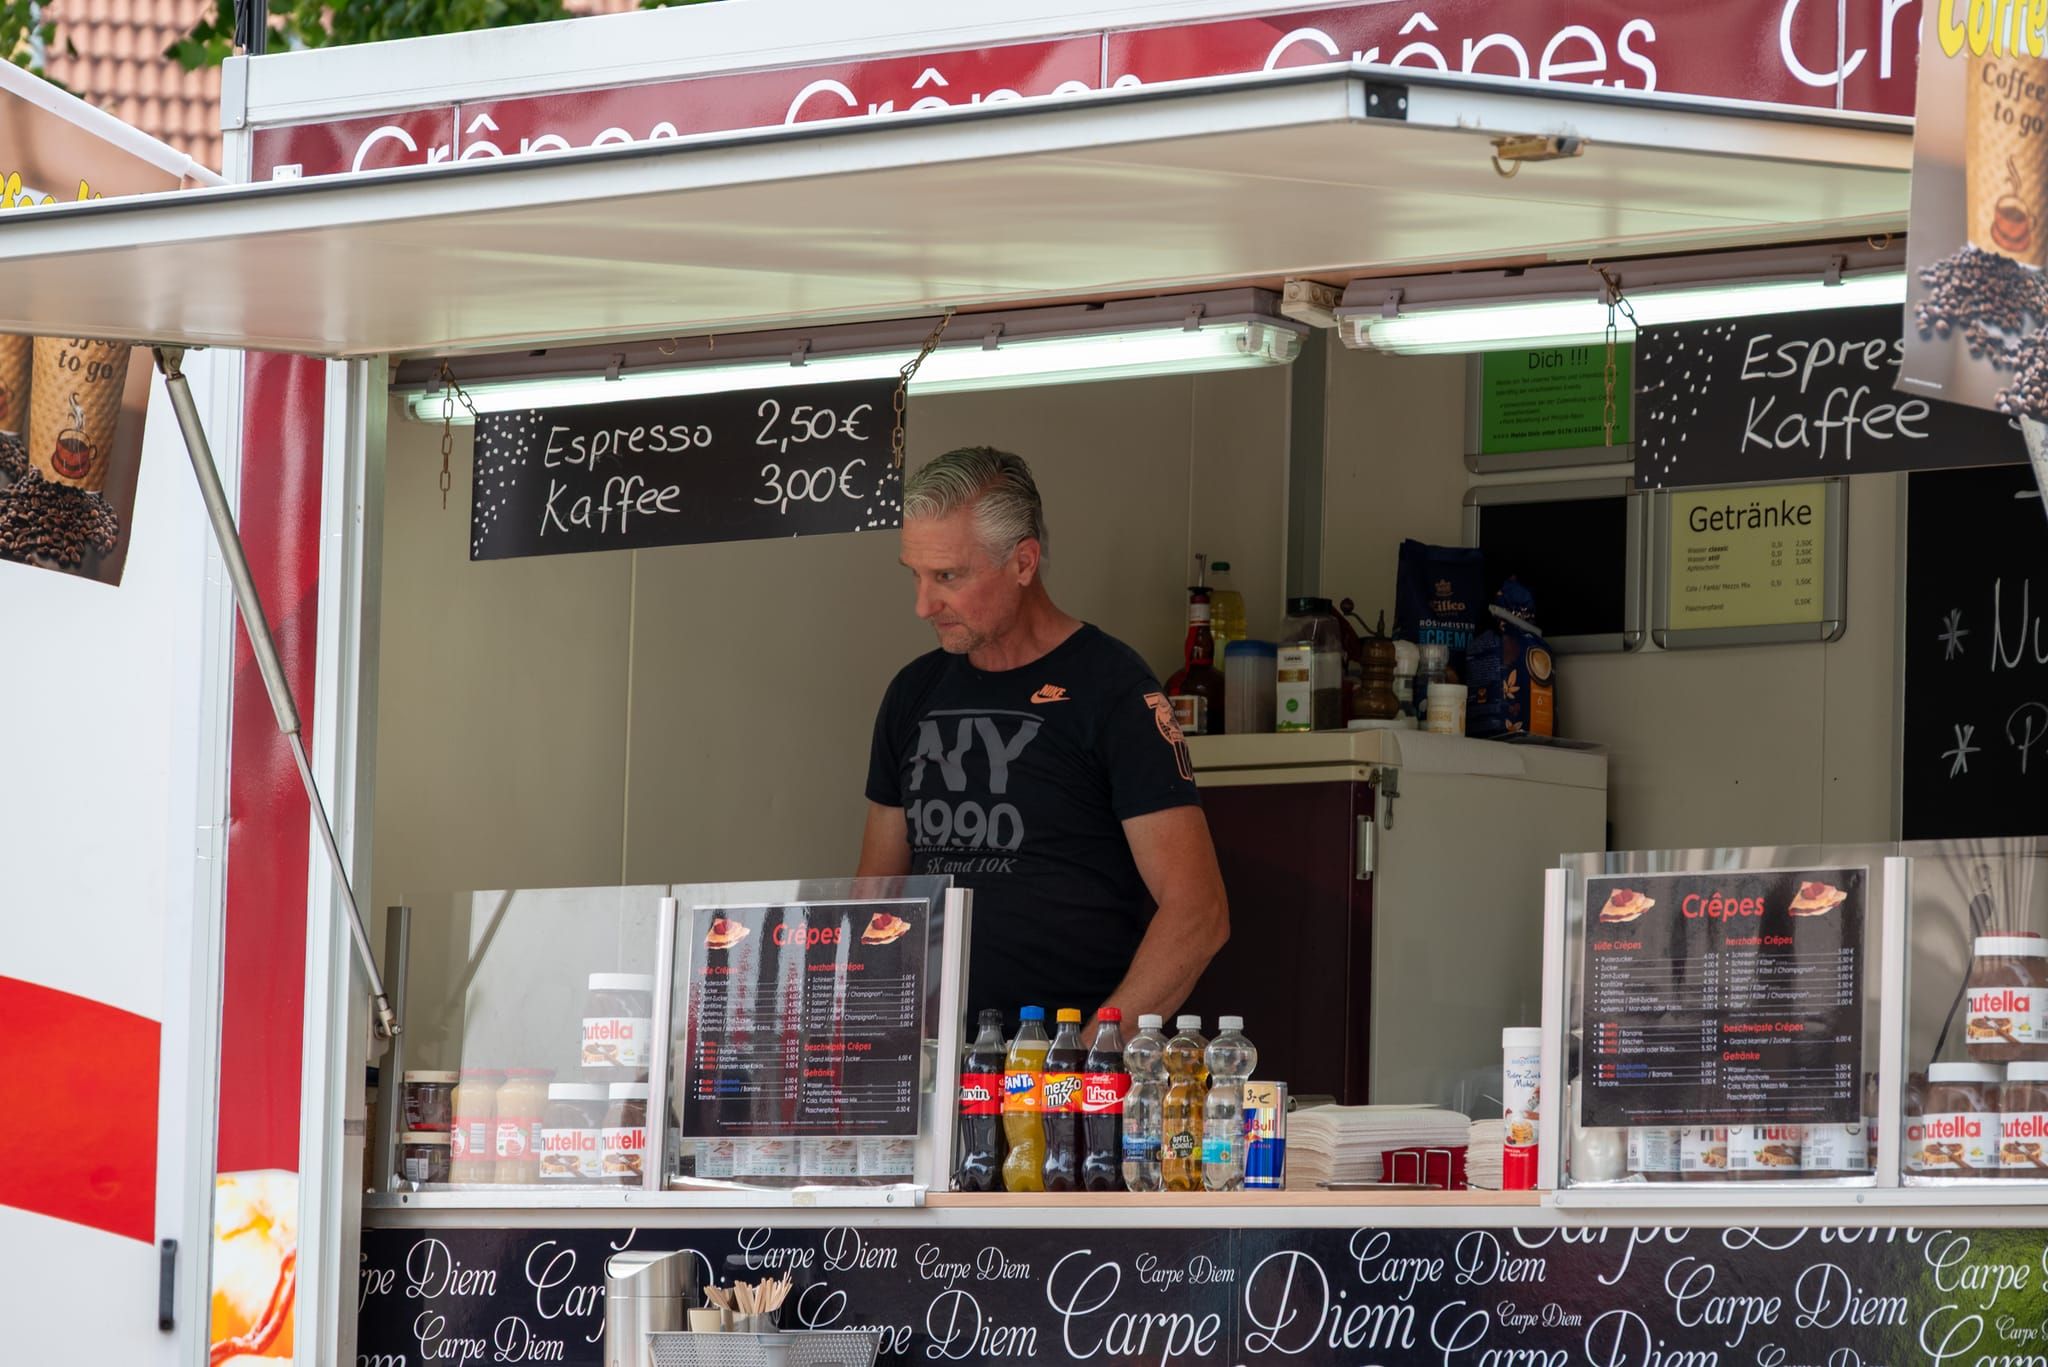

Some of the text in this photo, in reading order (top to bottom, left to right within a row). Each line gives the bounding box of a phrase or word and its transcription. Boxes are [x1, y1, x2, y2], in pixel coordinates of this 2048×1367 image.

[1982, 61, 2046, 103] Coffee
[1994, 101, 2043, 138] to go
[58, 349, 114, 383] to go
[1528, 351, 1563, 369] Dich
[1741, 386, 1930, 461] Kaffee
[543, 425, 712, 472] Espresso
[539, 475, 681, 537] Kaffee
[1689, 499, 1812, 533] Getränke
[907, 798, 1025, 851] 1990
[943, 856, 976, 873] and
[976, 857, 1019, 873] 10K
[1682, 891, 1765, 923] Crêpes
[772, 923, 842, 950] Crêpes
[1967, 990, 2030, 1013] nutella
[582, 1020, 633, 1040] nutella
[1722, 1051, 1760, 1061] Getränke
[1005, 1074, 1035, 1092] FANTA
[1044, 1076, 1082, 1097] mezzo
[1087, 1085, 1117, 1103] Lisa
[541, 1131, 596, 1151] nutella
[1921, 1115, 1982, 1138] nutella
[824, 1226, 898, 1271] Diem
[1349, 1227, 1445, 1302] Carpe
[1455, 1230, 1546, 1286] Diem
[405, 1238, 497, 1299] Diem
[914, 1243, 1031, 1291] Carpe Diem
[1135, 1252, 1236, 1293] Carpe Diem
[1924, 1230, 2030, 1311] Carpe
[1046, 1249, 1222, 1367] Carpe
[1244, 1250, 1415, 1355] Diem
[1496, 1300, 1582, 1335] Carpe Diem
[1664, 1256, 1782, 1349] Carpe
[1795, 1263, 1908, 1329] Diem
[413, 1311, 565, 1367] Carpe Diem
[925, 1289, 1038, 1361] Diem
[1995, 1314, 2038, 1348] Carpe
